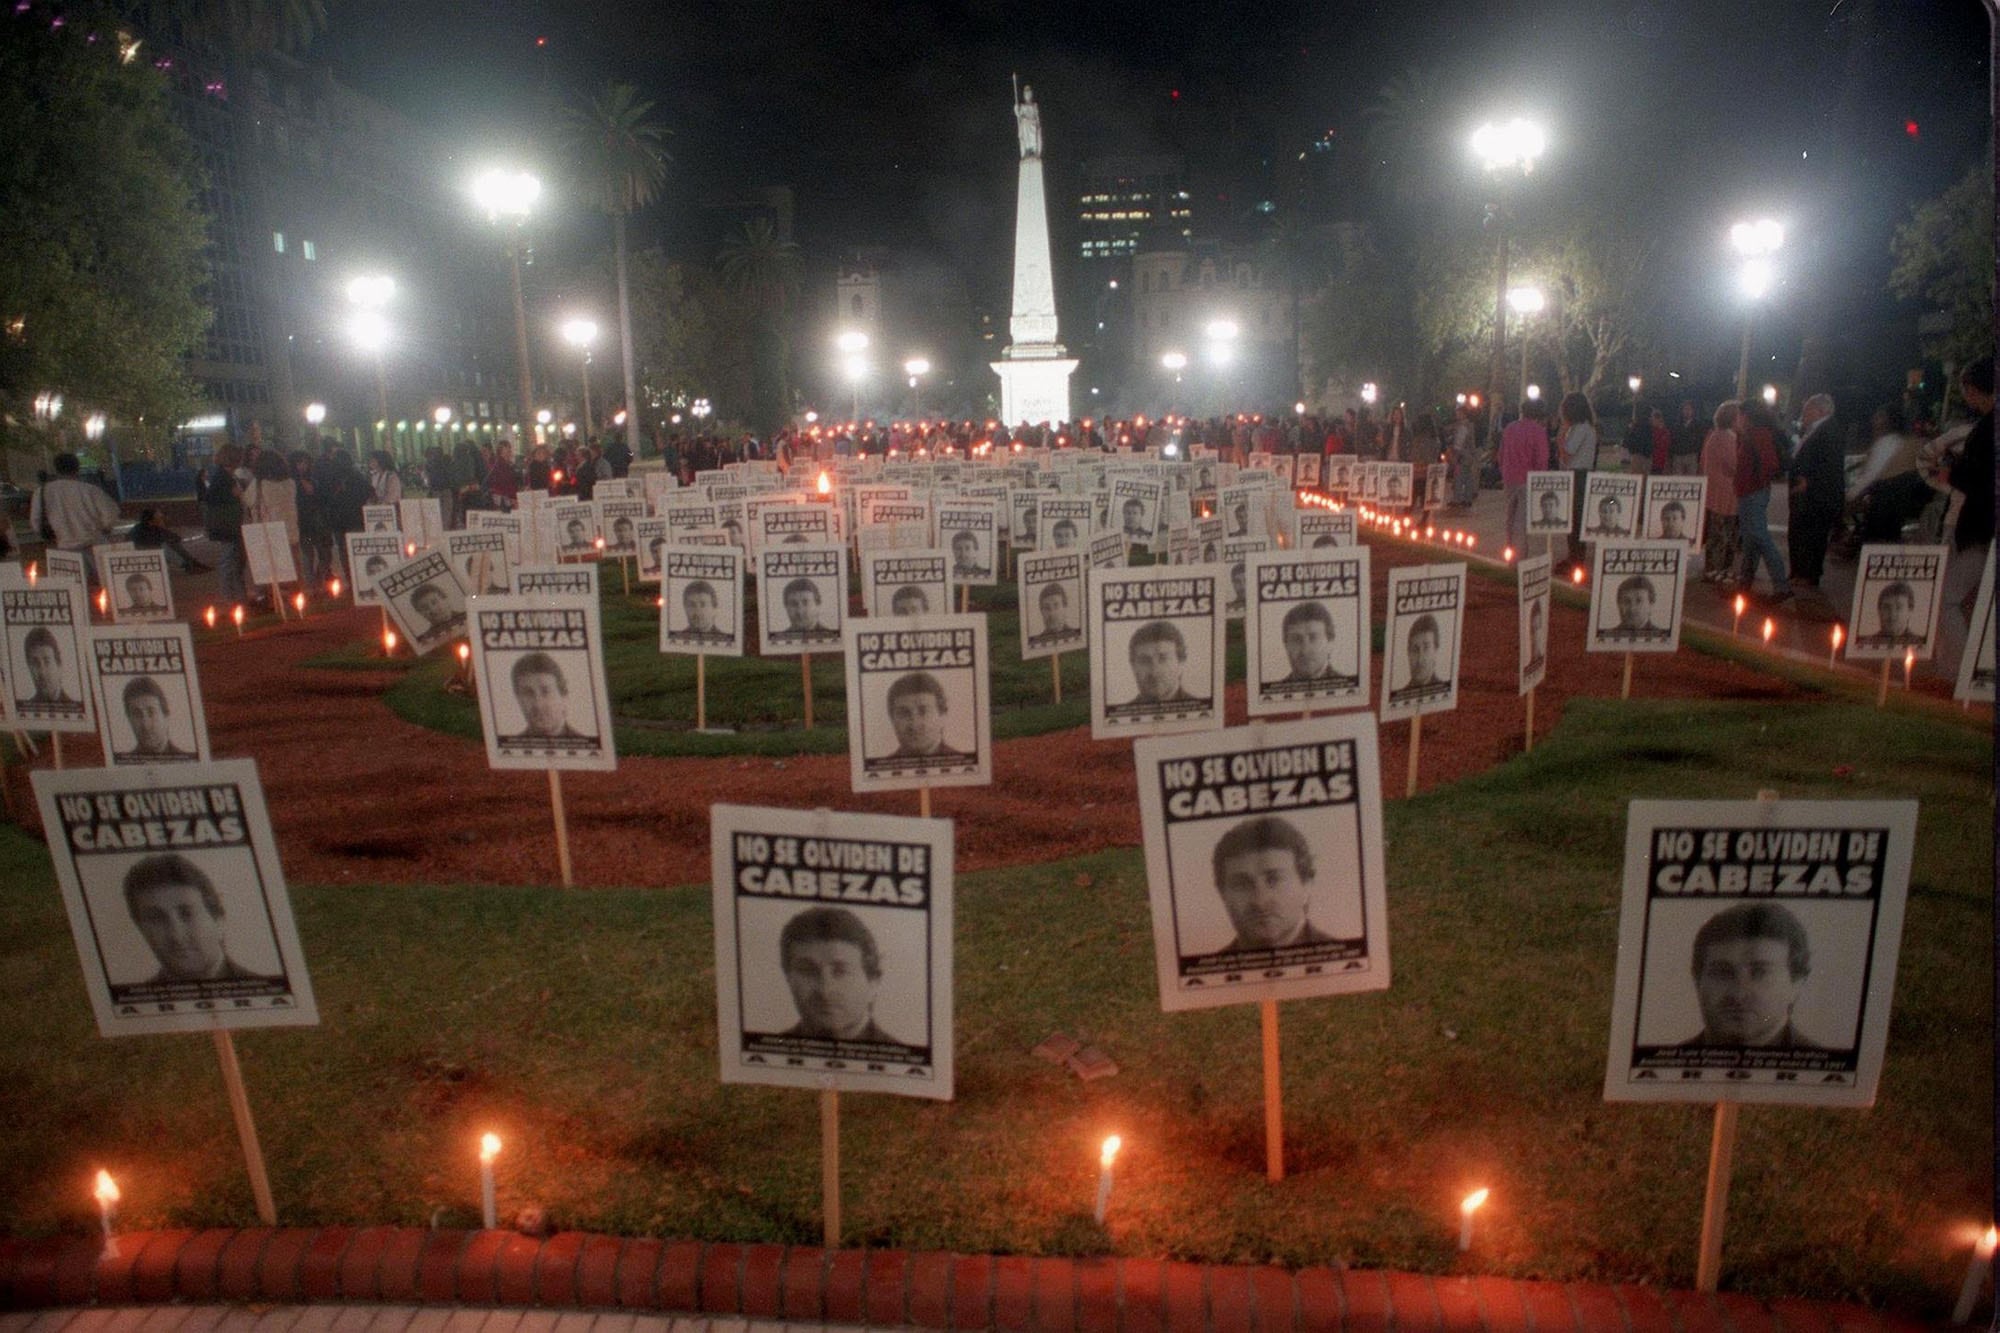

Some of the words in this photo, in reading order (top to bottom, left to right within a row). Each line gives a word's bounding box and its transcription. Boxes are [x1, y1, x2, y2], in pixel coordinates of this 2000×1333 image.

[670, 565, 732, 577] CABEZAS
[768, 563, 836, 575] CABEZAS
[876, 571, 942, 583] CABEZAS
[1260, 567, 1277, 583] NO
[1279, 566, 1292, 581] SE
[1295, 563, 1339, 580] OLVIDEN
[1343, 562, 1355, 577] DE
[1605, 562, 1676, 572] CABEZAS
[1105, 584, 1122, 601] NO
[1125, 583, 1139, 600] SE
[1142, 580, 1191, 599] OLVIDEN
[1196, 579, 1210, 596] DE
[1261, 579, 1355, 599] CABEZAS
[1106, 598, 1210, 619] CABEZAS
[1397, 593, 1456, 612] CABEZAS
[5, 608, 70, 623] CABEZAS
[482, 613, 501, 629] NO
[502, 613, 517, 629] SE
[519, 612, 565, 628] OLVIDEN
[568, 612, 582, 628] DE
[96, 641, 112, 655] NO
[113, 640, 126, 655] SE
[127, 640, 166, 655] OLVIDEN
[168, 639, 180, 654] DE
[484, 630, 584, 648] CABEZAS
[860, 635, 879, 652] NO
[883, 634, 897, 651] SE
[901, 631, 951, 650] OLVIDEN
[956, 631, 970, 647] DE
[99, 656, 182, 672] CABEZAS
[861, 649, 970, 670] CABEZAS
[1164, 761, 1196, 788] NO
[1202, 757, 1226, 784] SE
[1231, 747, 1320, 781] OLVIDEN
[1325, 744, 1351, 770] DE
[60, 797, 92, 822] NO
[97, 795, 120, 819] SE
[124, 790, 207, 816] OLVIDEN
[209, 787, 237, 813] DE
[1168, 776, 1352, 818] CABEZAS
[73, 817, 245, 849] CABEZAS
[737, 836, 769, 862] NO
[774, 839, 799, 865] SE
[803, 841, 892, 870] OLVIDEN
[898, 847, 926, 874] DE
[1657, 832, 1695, 860] NO
[1701, 832, 1731, 860] SE
[1736, 832, 1840, 861] OLVIDEN
[1847, 833, 1878, 861] DE
[739, 866, 925, 904] CABEZAS
[1655, 864, 1874, 894] CABEZAS
